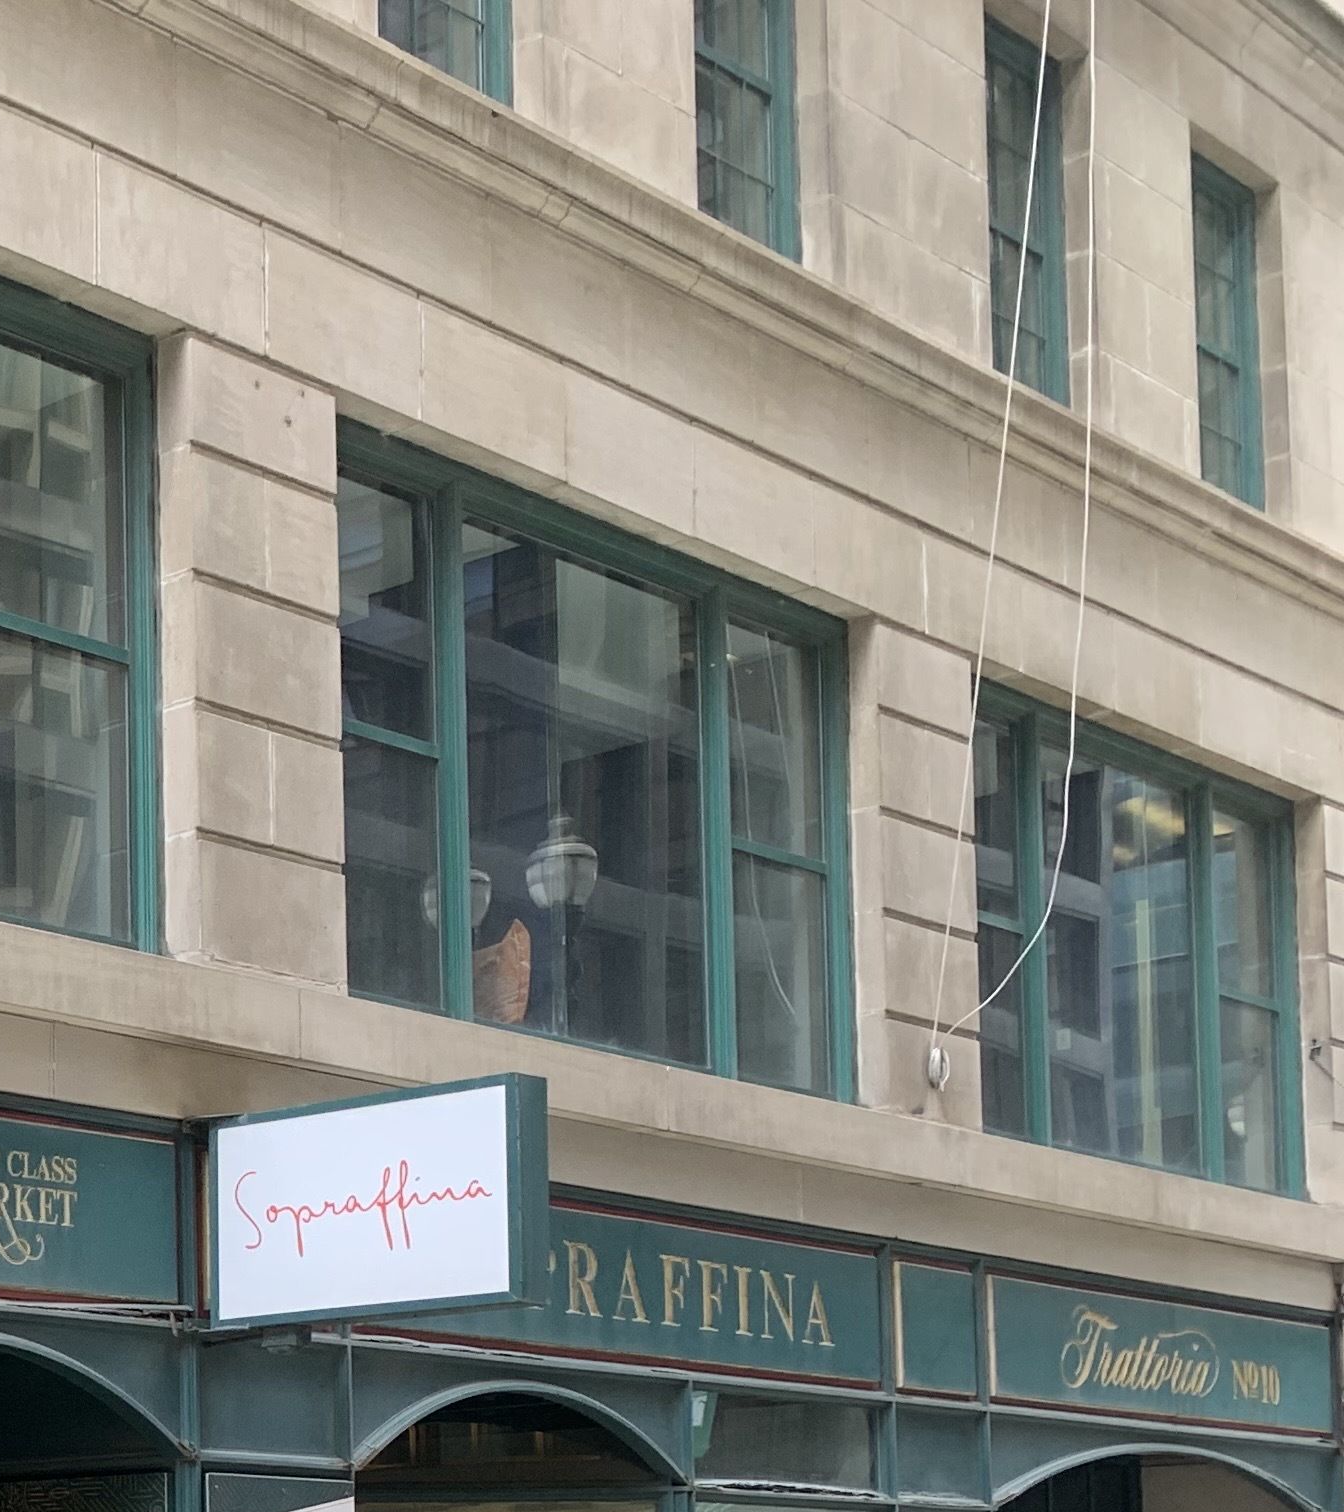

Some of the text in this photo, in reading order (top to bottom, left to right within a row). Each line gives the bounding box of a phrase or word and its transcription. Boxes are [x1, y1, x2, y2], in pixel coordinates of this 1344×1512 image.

[7, 1150, 78, 1184] CLASS
[235, 1159, 492, 1257] Sopraffina
[547, 1239, 835, 1346] RAFFINA
[1060, 1304, 1220, 1398] Trattoria
